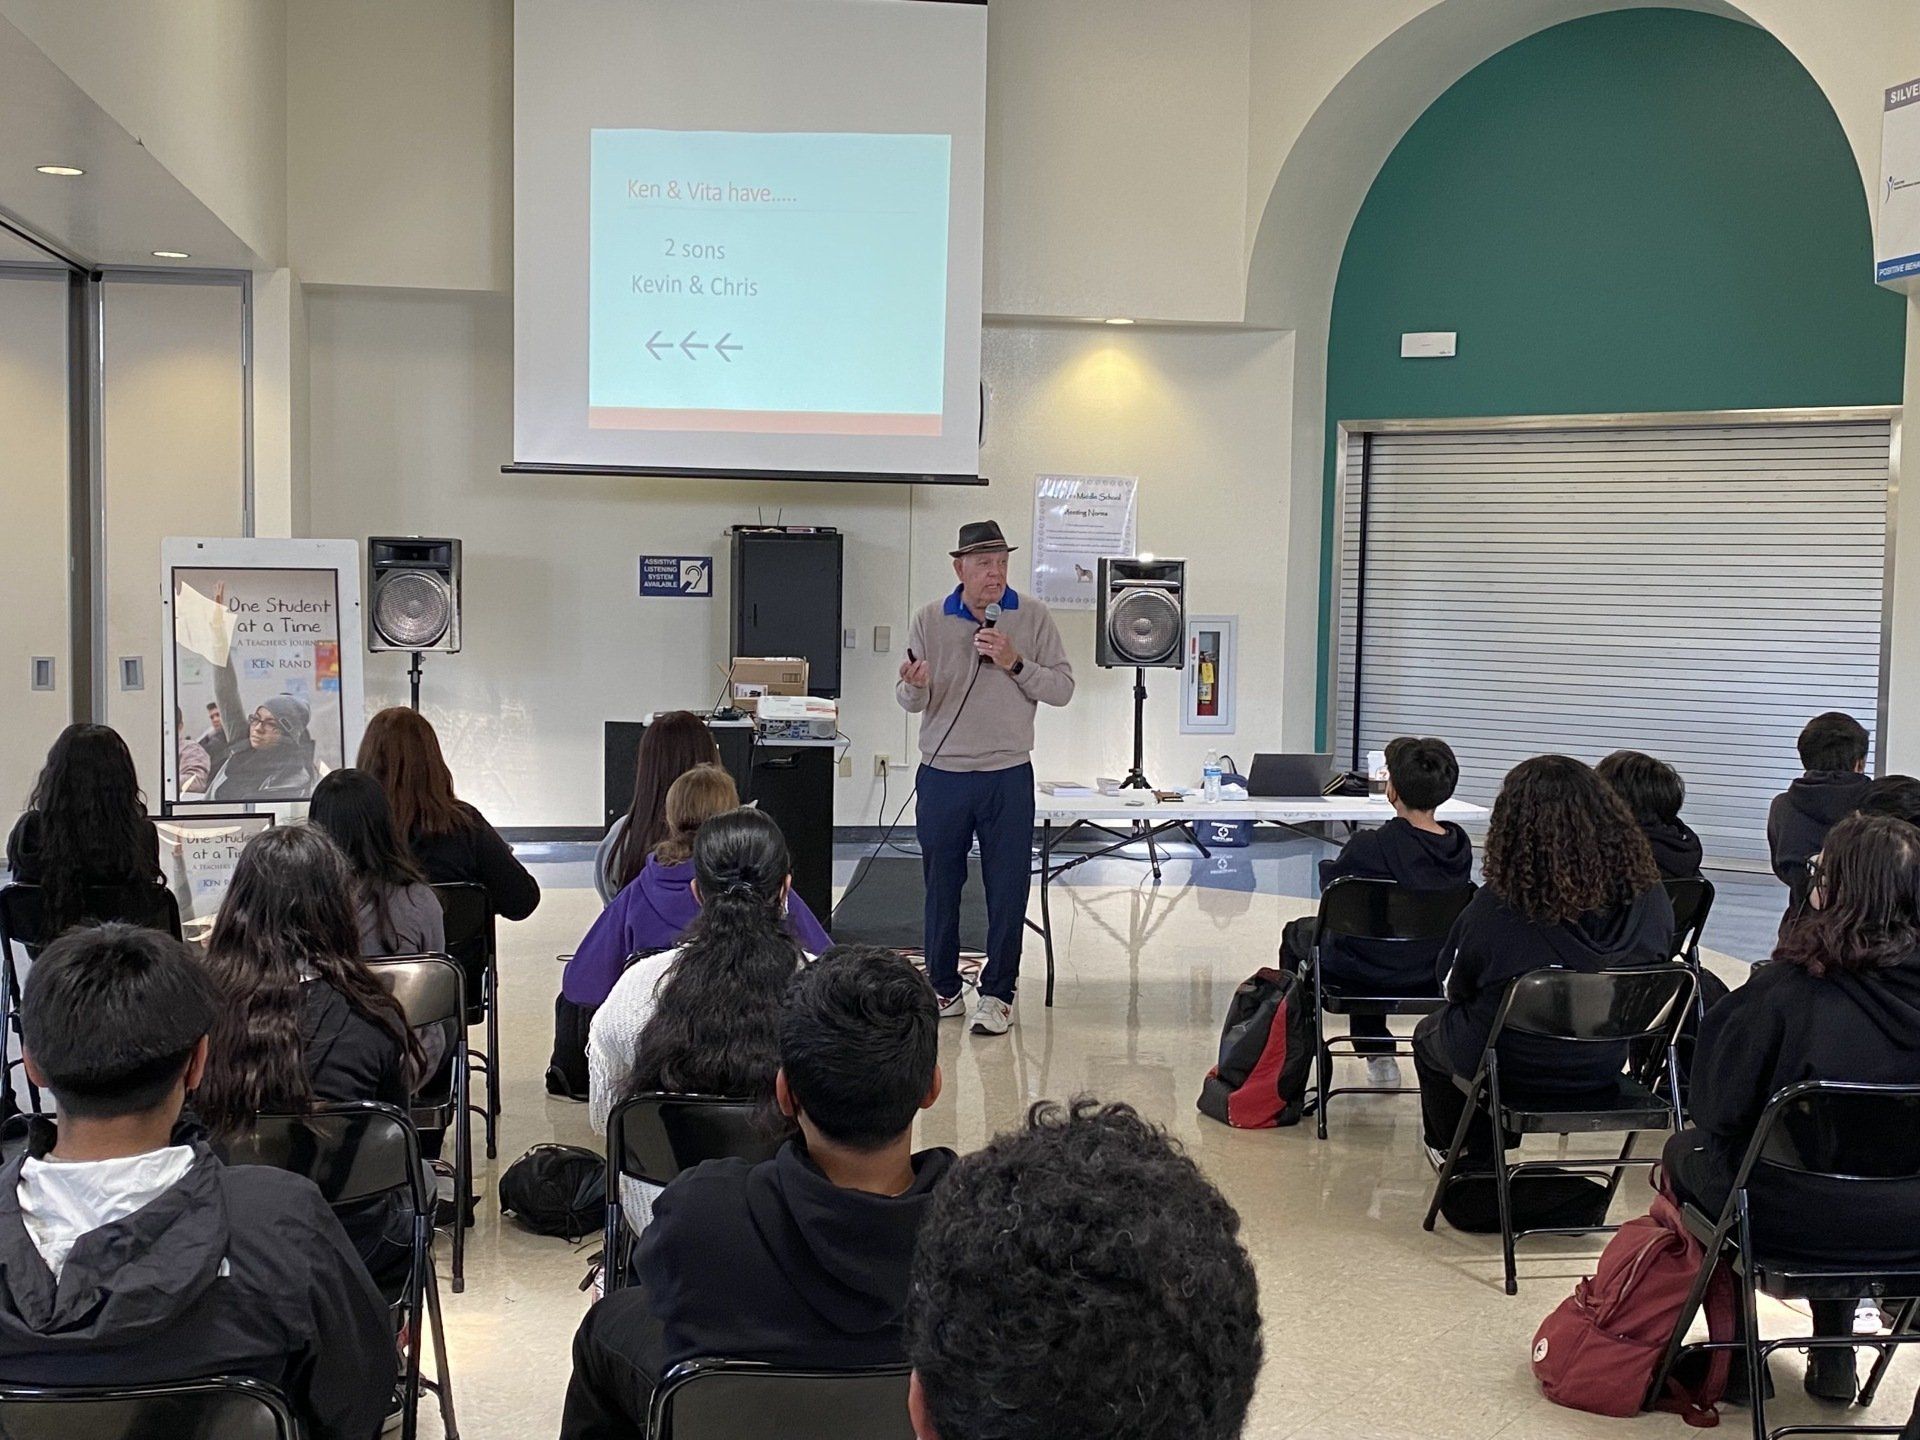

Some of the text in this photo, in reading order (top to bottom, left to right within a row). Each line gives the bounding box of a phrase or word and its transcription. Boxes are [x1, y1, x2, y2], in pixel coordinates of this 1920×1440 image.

[1890, 83, 1920, 103] SILVE
[627, 179, 797, 203] Ken & Vita have.....
[664, 239, 725, 260] 2 sons
[631, 274, 758, 297] Kevin & Chris
[1098, 493, 1121, 501] School
[229, 596, 331, 613] One Student
[237, 617, 321, 633] at a Time
[252, 659, 312, 669] KEN RAND
[215, 831, 253, 844] Stude
[192, 846, 241, 860] at a Ti
